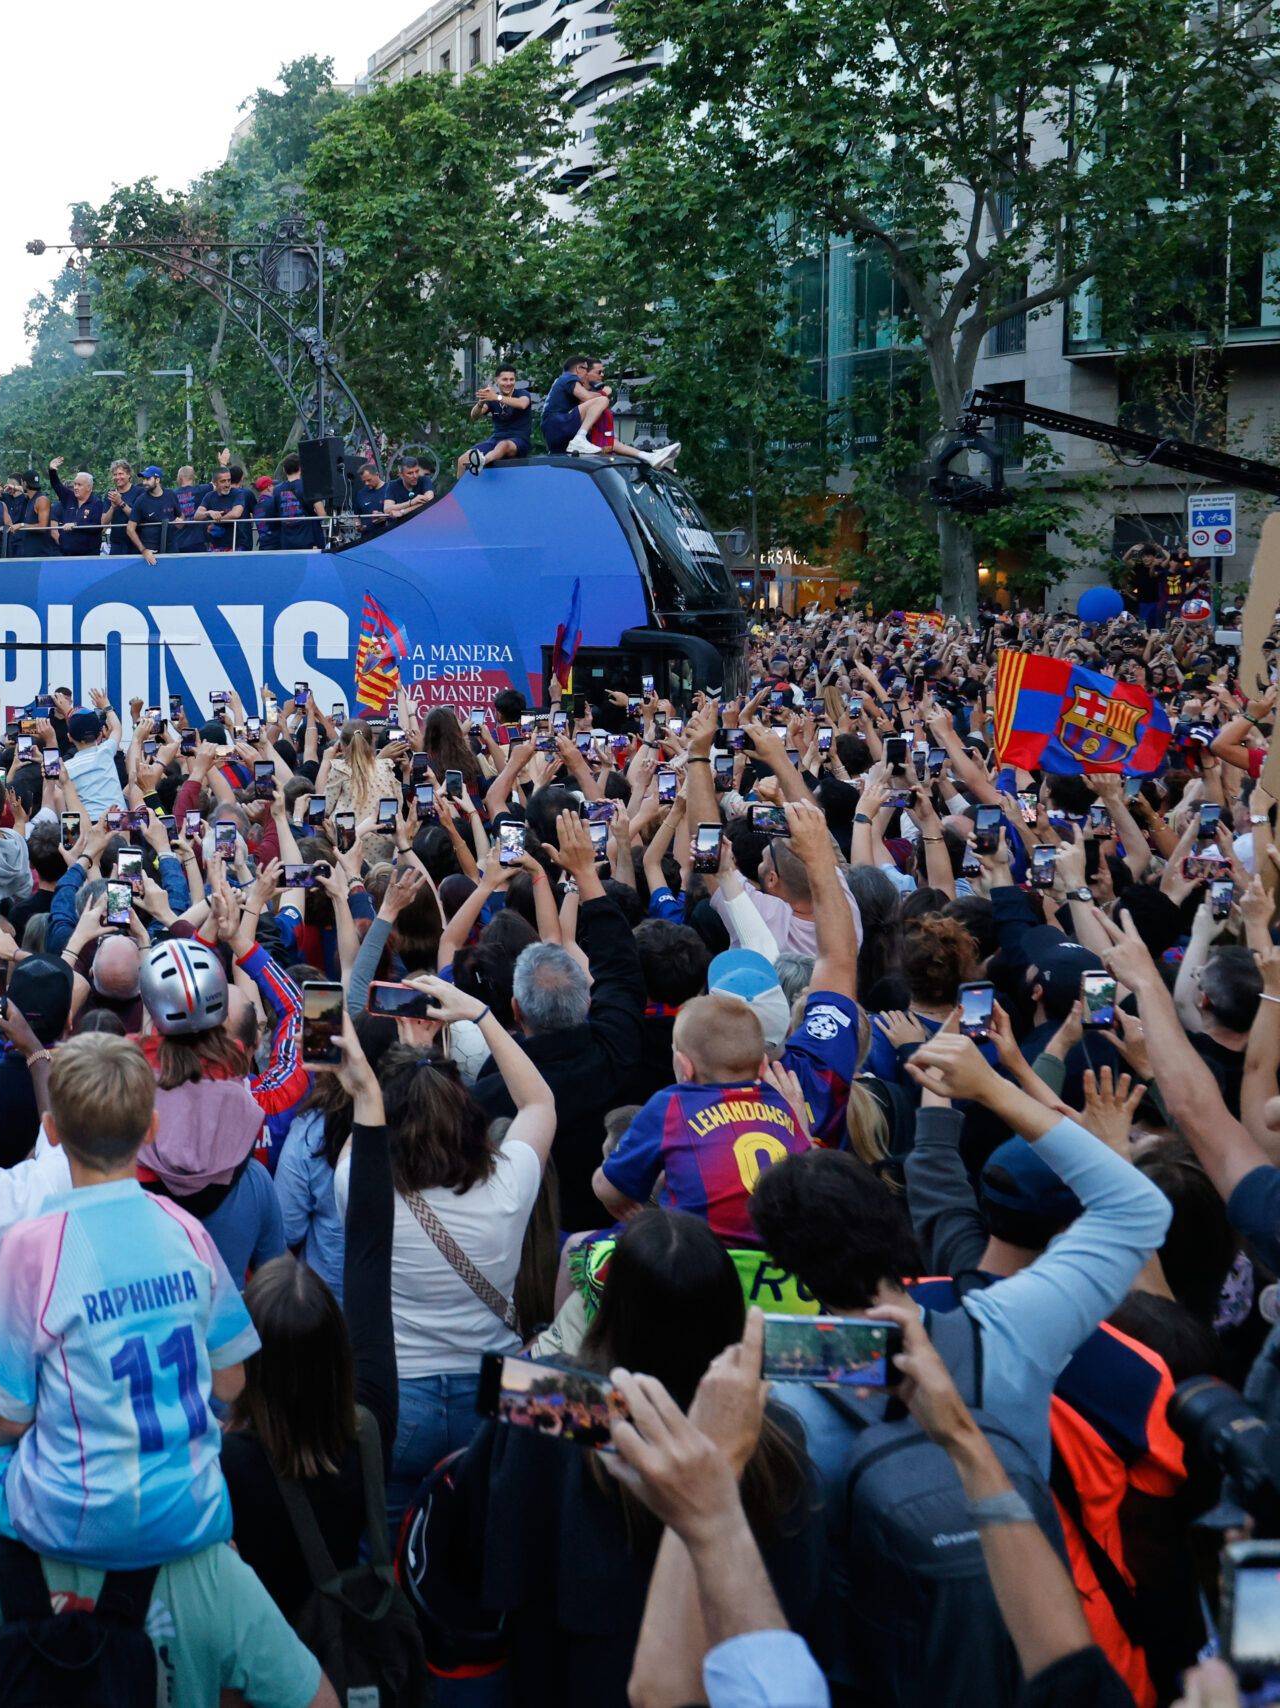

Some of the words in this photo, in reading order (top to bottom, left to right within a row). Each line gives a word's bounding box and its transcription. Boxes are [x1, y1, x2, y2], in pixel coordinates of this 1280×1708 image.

[752, 549, 810, 565] ERSAC
[431, 645, 513, 662] MANERA
[413, 665, 438, 681] DE
[443, 665, 483, 682] SER
[1084, 719, 1113, 737] FCB
[688, 1100, 795, 1137] LEWANDOWSKI
[82, 1269, 198, 1325] RAPHINHA
[110, 1324, 208, 1454] 11
